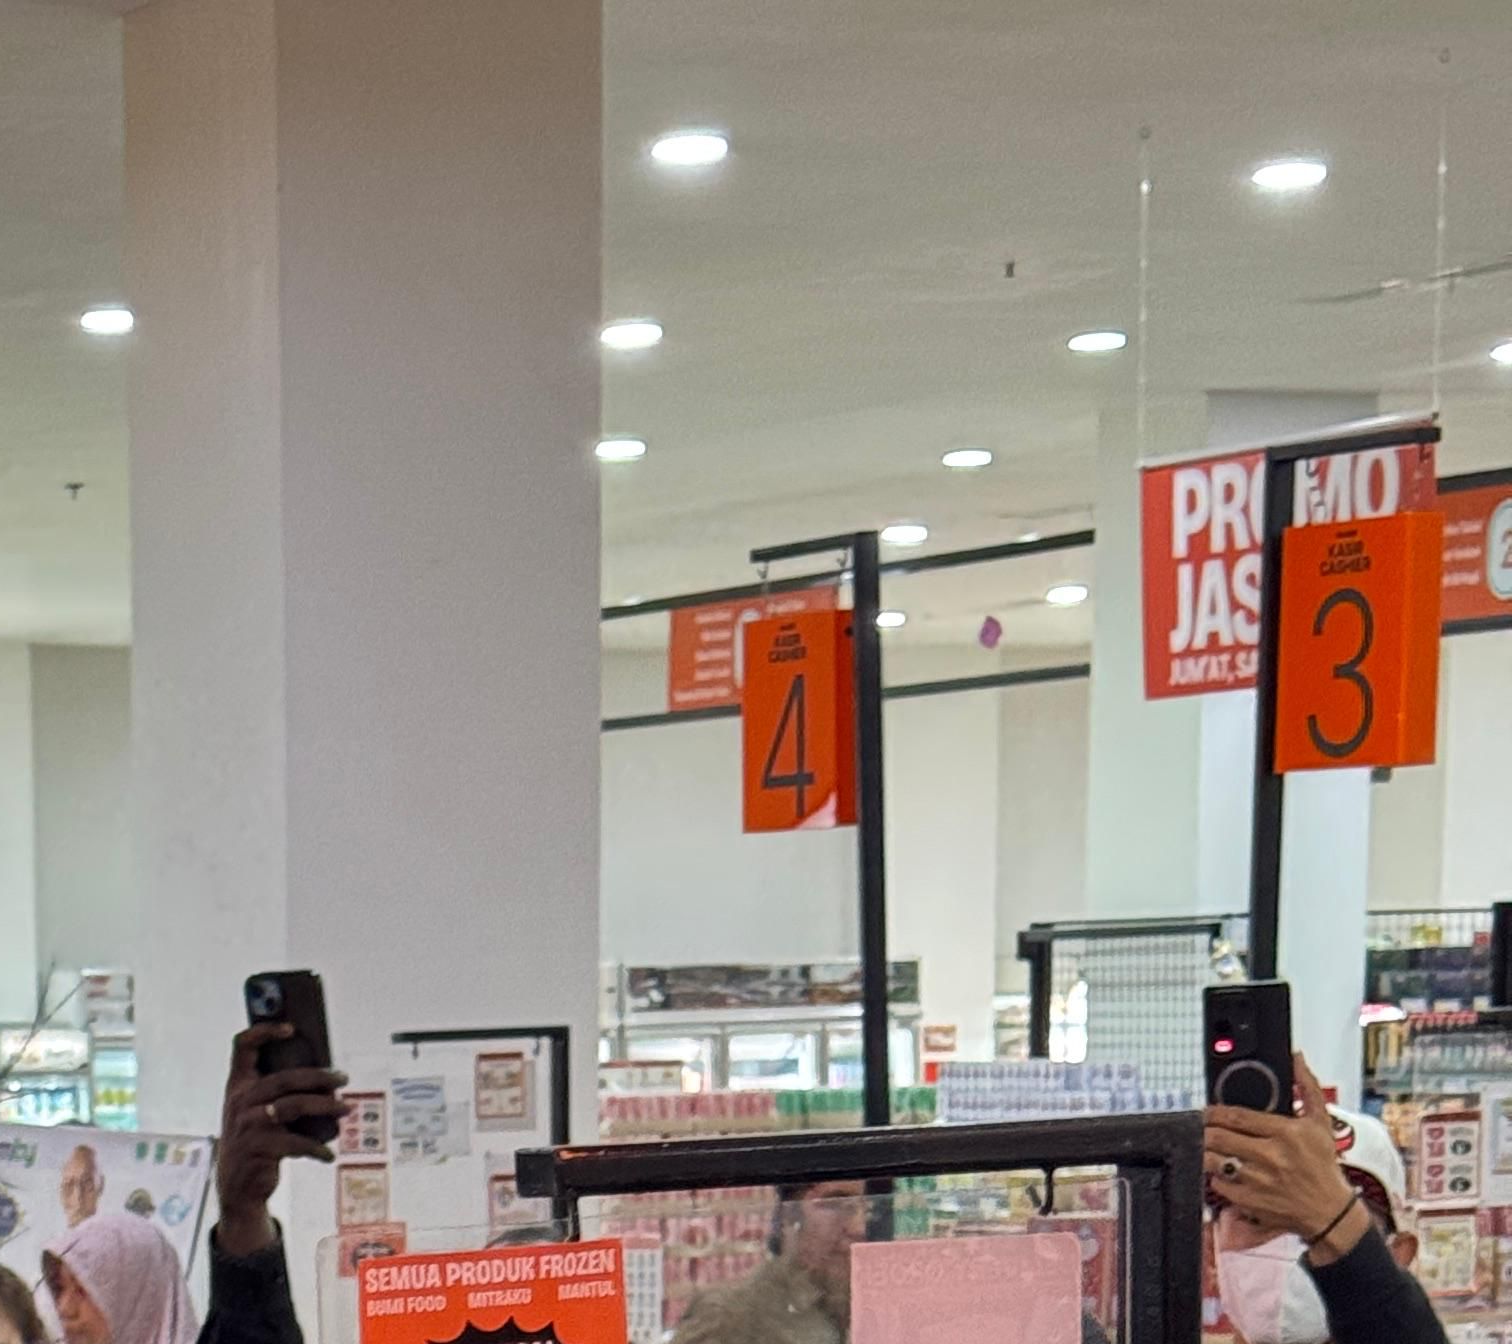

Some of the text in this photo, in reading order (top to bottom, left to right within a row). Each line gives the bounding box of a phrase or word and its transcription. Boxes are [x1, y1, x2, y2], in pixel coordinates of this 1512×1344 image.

[1320, 556, 1371, 577] CASHIER
[1327, 541, 1364, 558] KASIR
[1169, 554, 1263, 654] JAS
[1306, 587, 1375, 759] 3
[762, 674, 815, 818] 4
[365, 1249, 616, 1293] SEMUA PRODUK FROZEN
[366, 1280, 617, 1317] BUMI FOOD MITRAKU MANTUL
